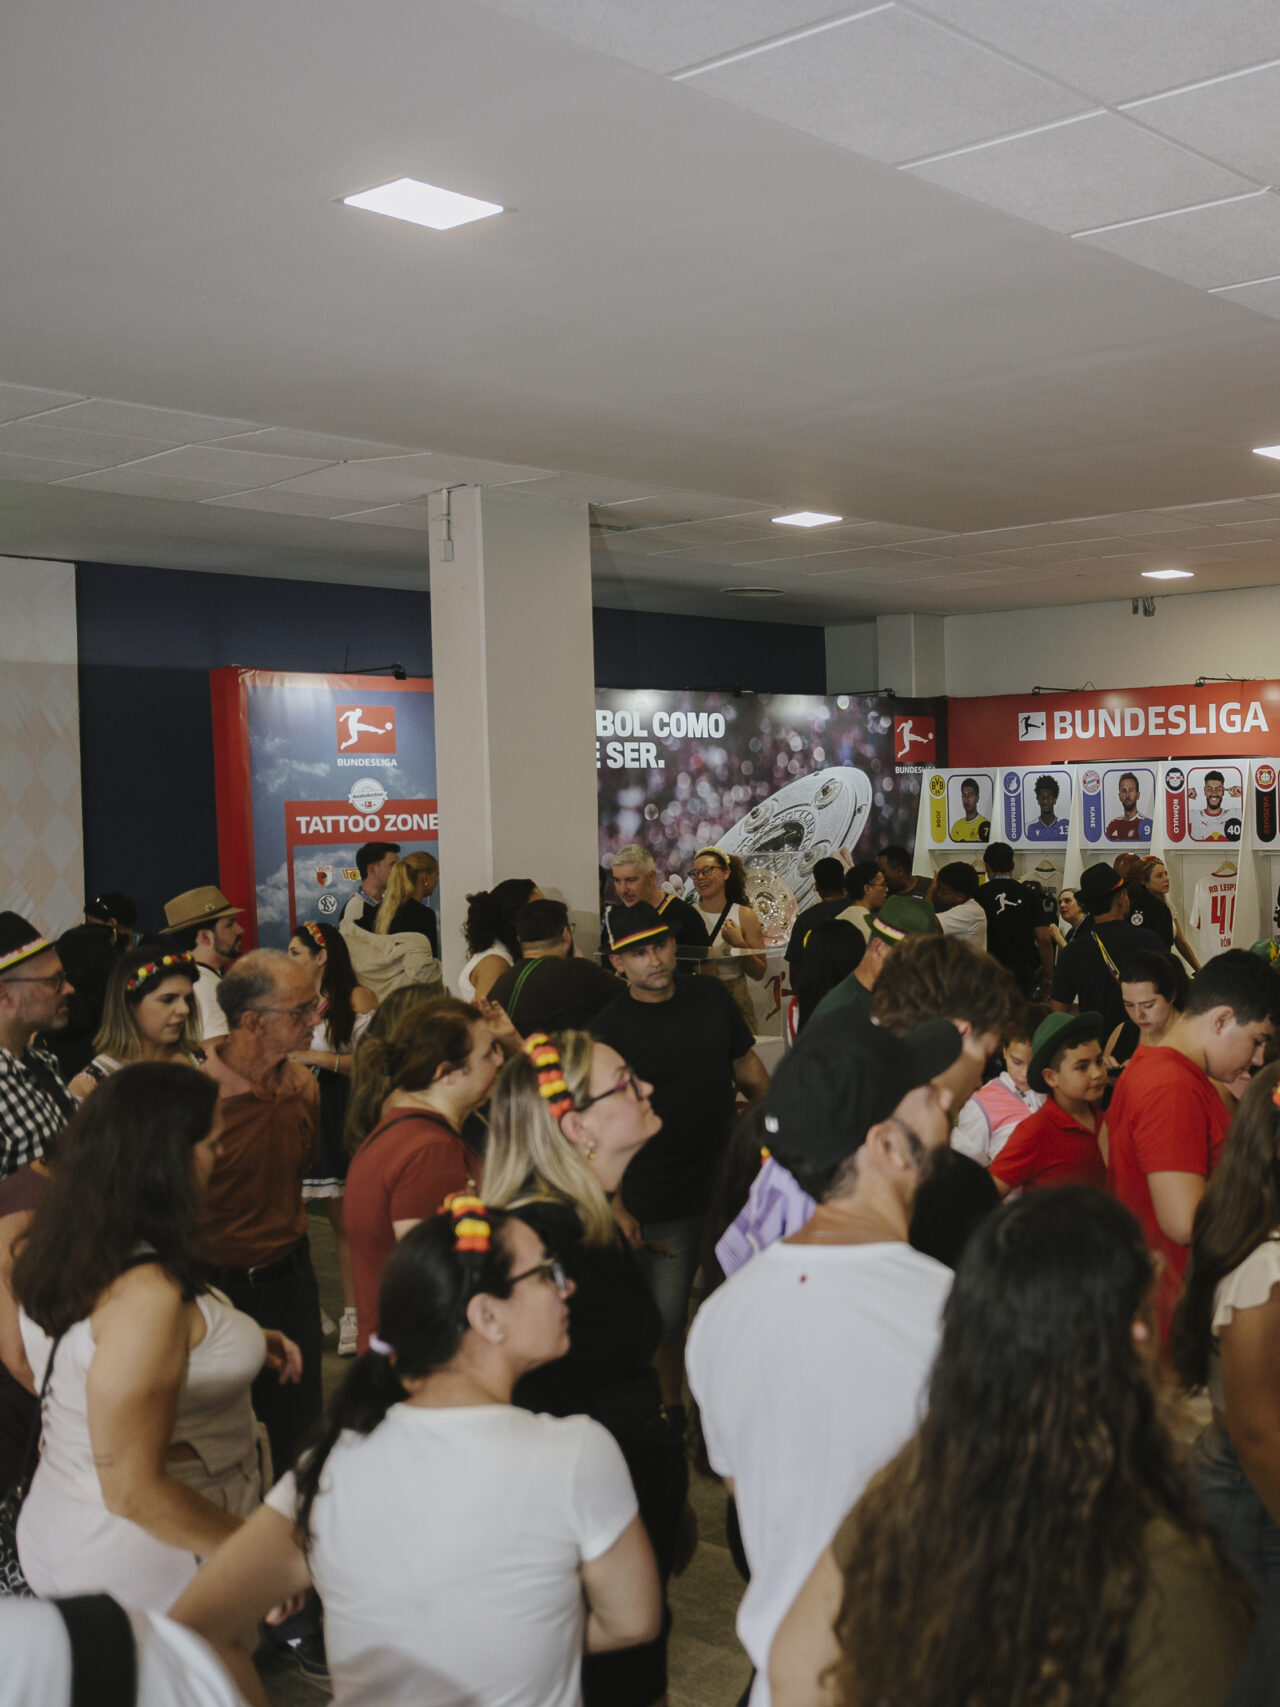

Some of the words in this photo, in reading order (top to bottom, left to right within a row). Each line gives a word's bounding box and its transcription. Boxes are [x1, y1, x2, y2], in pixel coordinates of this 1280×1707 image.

[595, 709, 649, 738] BOL
[652, 711, 726, 739] COMO
[1053, 701, 1270, 740] BUNDESLIGA
[606, 741, 666, 769] SER.
[336, 758, 398, 767] BUNDESLIGA
[895, 766, 936, 774] BUNDES
[931, 777, 944, 790] BVB
[1172, 799, 1180, 834] RÔMULO
[296, 814, 380, 835] TATTOO
[384, 812, 440, 833] ZONE
[983, 828, 989, 837] 7
[1144, 825, 1151, 835] 9
[1227, 825, 1240, 835] 40
[1208, 885, 1219, 893] RB
